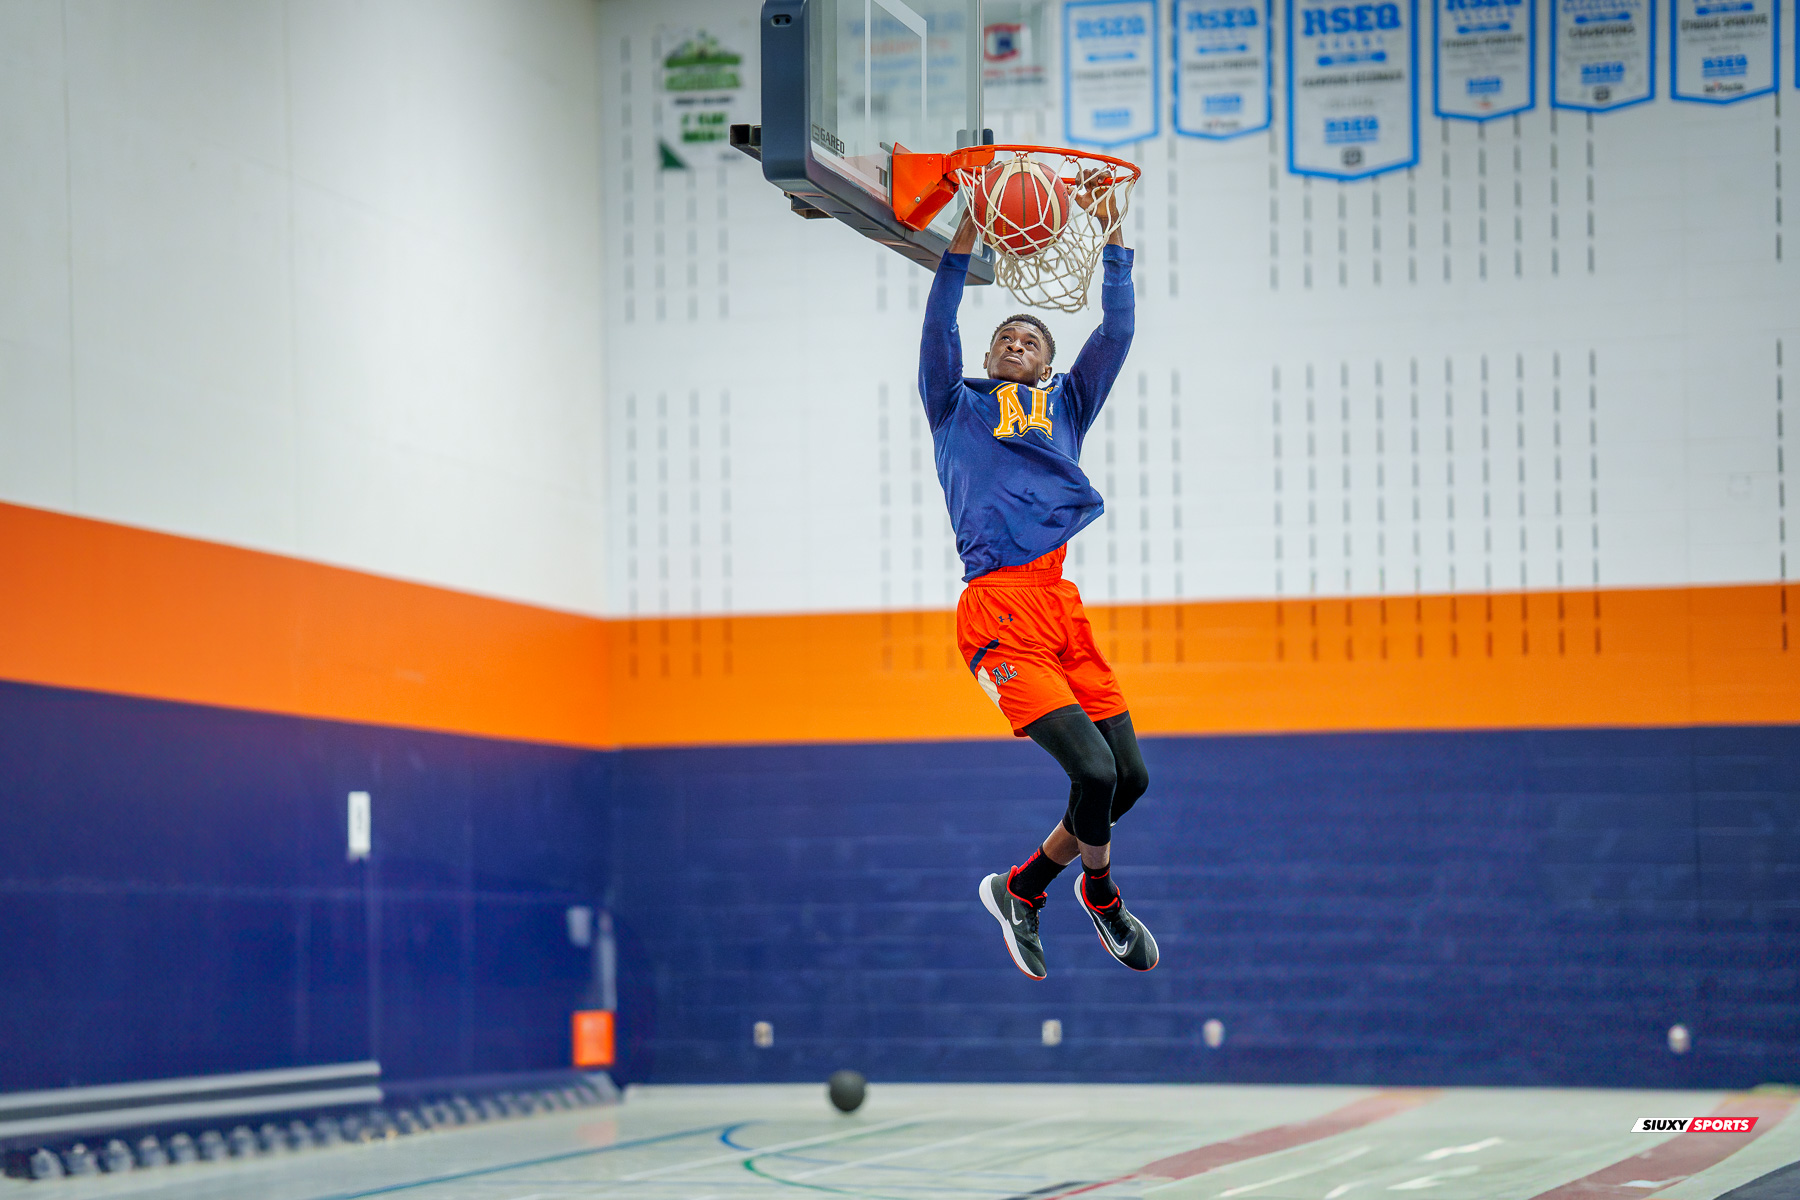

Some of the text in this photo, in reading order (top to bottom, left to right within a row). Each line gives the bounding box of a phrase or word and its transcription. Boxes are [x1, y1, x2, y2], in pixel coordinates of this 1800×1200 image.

[1304, 4, 1401, 36] RSEQ
[820, 127, 845, 155] GARED
[993, 383, 1053, 437] AL
[992, 661, 1018, 687] AL
